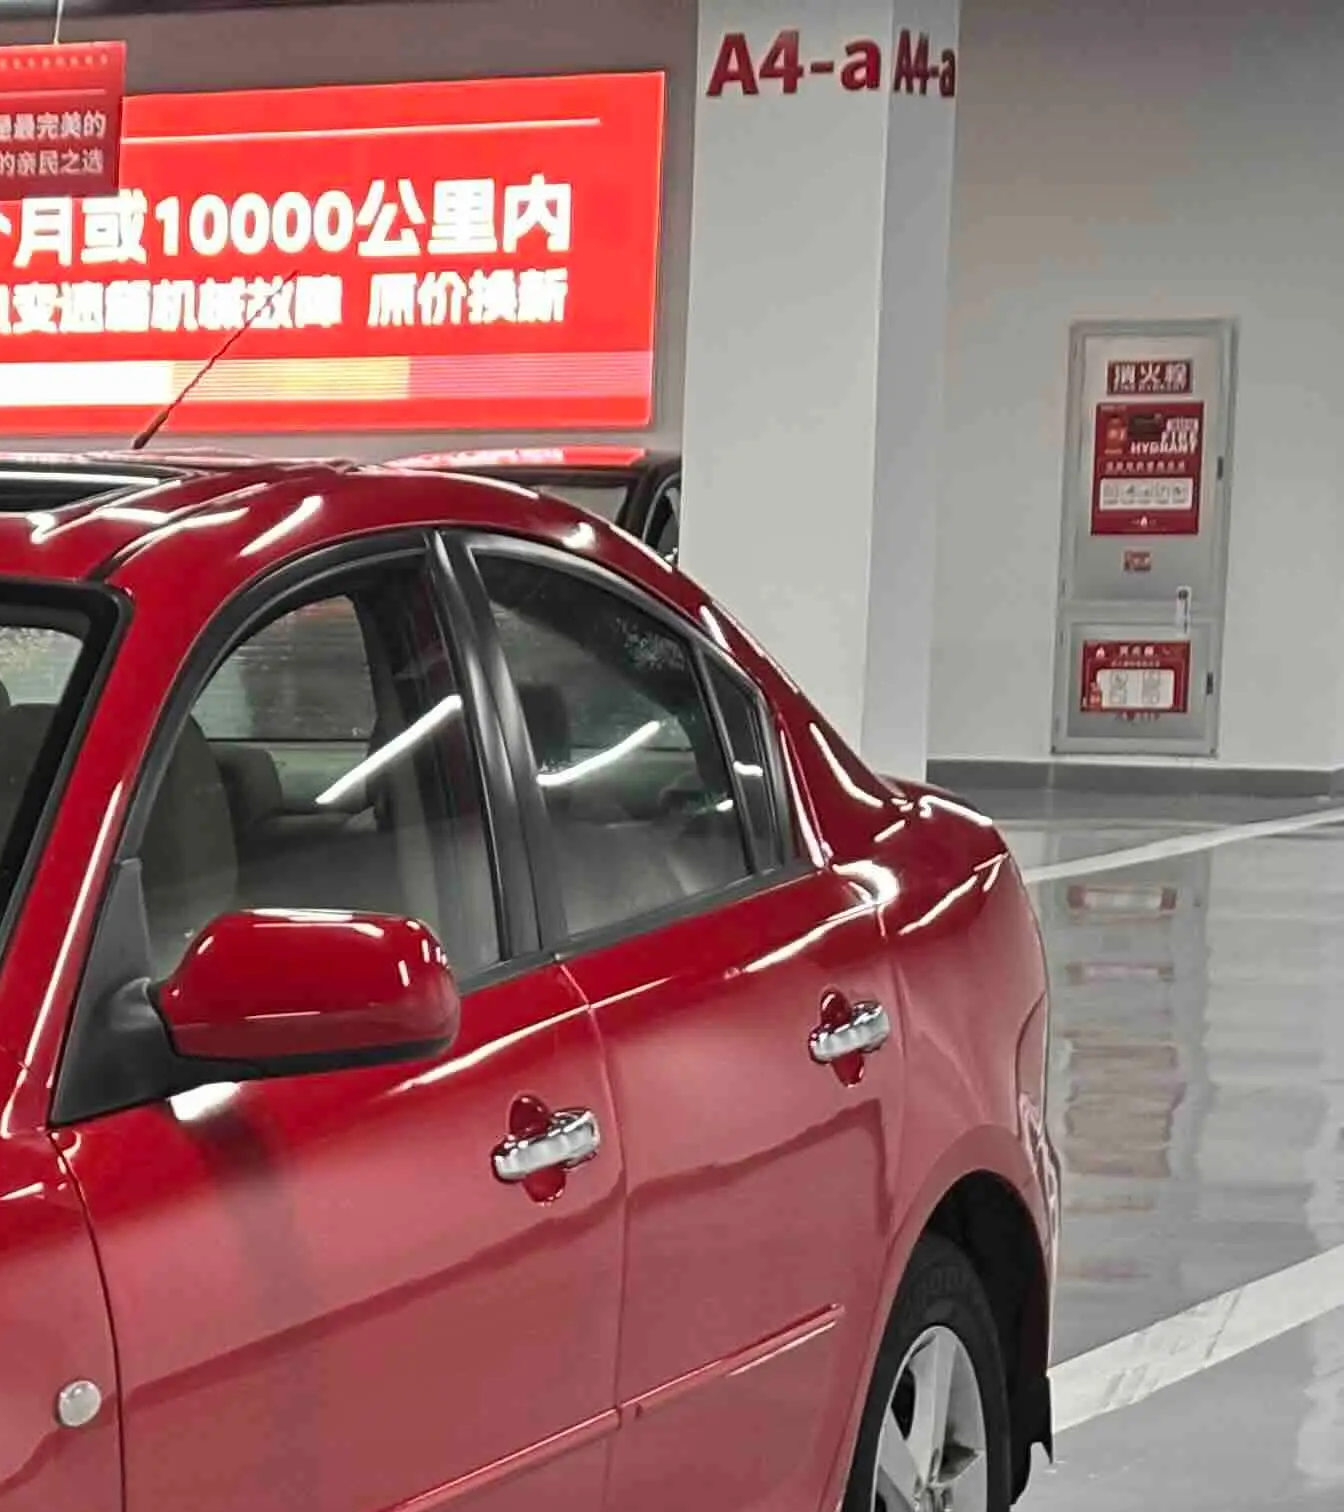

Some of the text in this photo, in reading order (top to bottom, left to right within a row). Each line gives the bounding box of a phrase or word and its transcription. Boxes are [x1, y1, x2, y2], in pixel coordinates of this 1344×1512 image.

[705, 28, 882, 97] A4-a
[893, 28, 957, 97] A4-a
[368, 267, 569, 329] 原价换新
